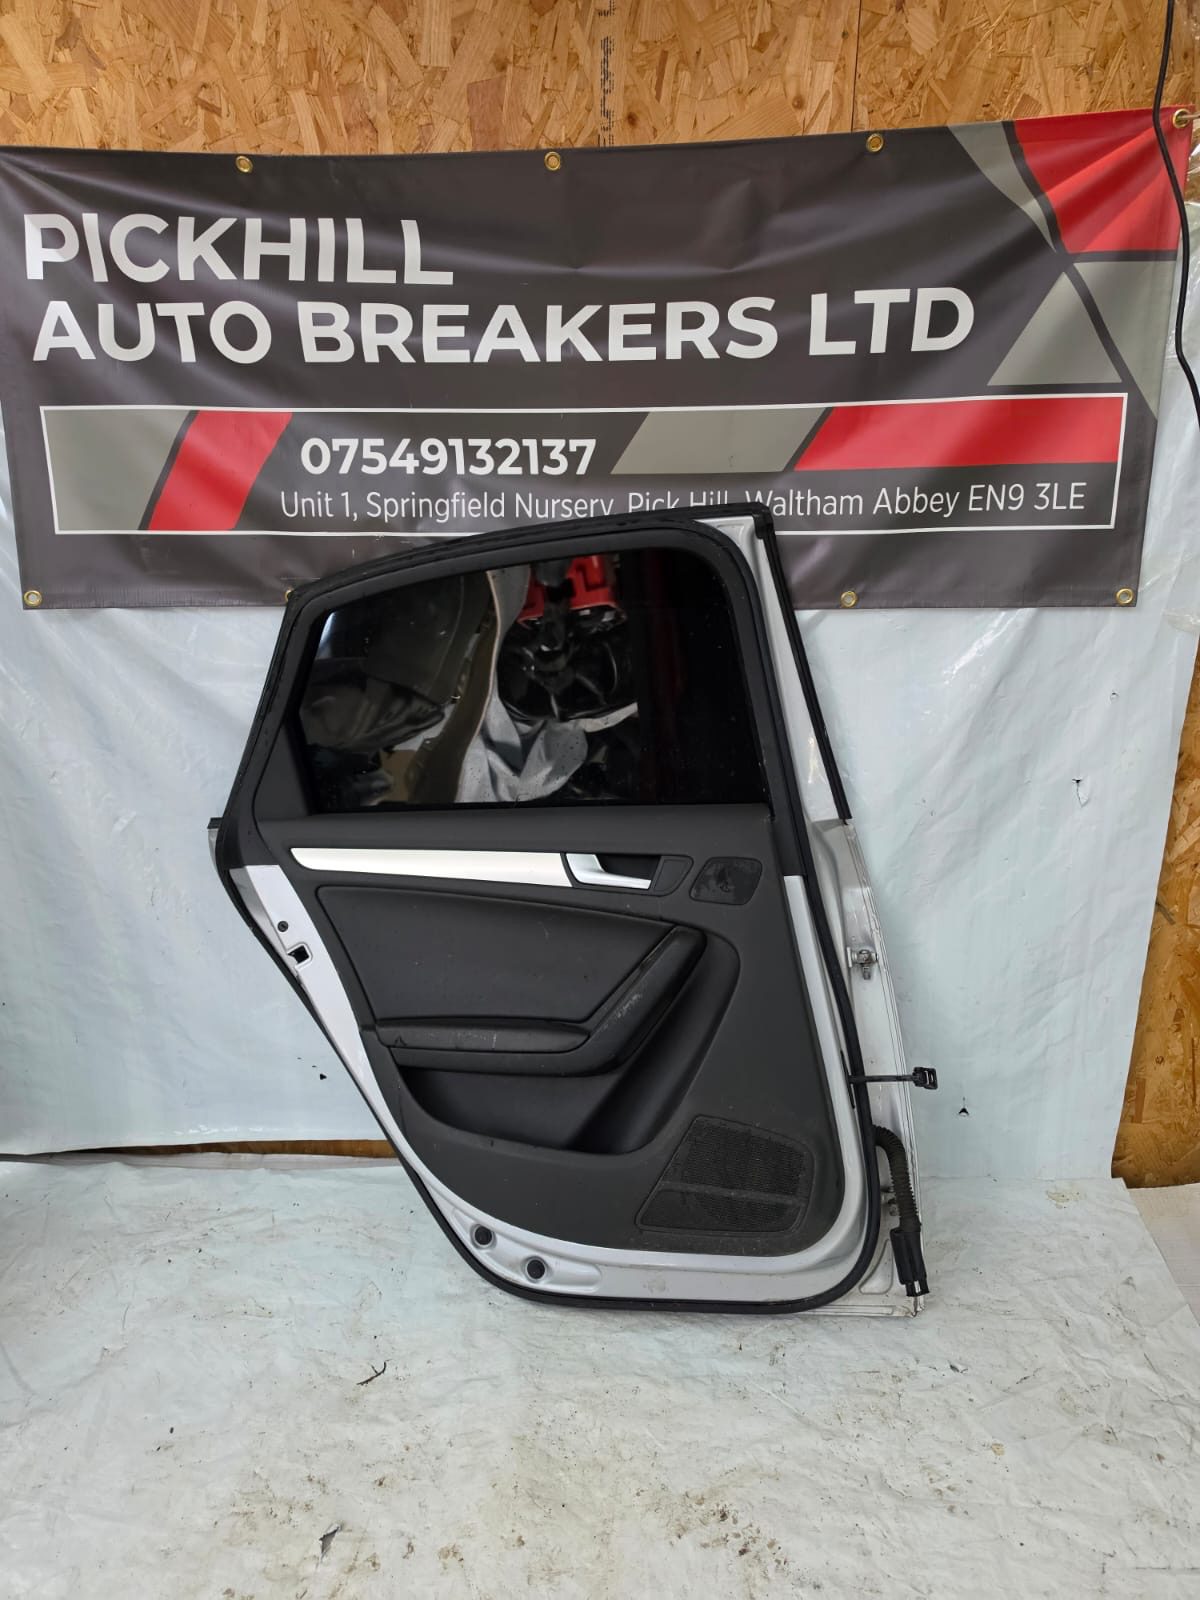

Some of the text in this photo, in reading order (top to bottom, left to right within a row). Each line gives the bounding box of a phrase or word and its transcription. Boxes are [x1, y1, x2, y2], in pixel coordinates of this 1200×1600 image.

[23, 212, 454, 286] PICKHILL
[32, 287, 975, 364] AUTO BREAKERS LTD
[300, 437, 597, 476] 07549132137
[280, 490, 335, 518] Unit
[340, 491, 358, 522] 1,
[366, 490, 505, 524] Springfield
[628, 490, 680, 513] Pick
[872, 486, 960, 518] Abbey
[968, 483, 1025, 511] EN9
[1033, 482, 1087, 511] 3LE
